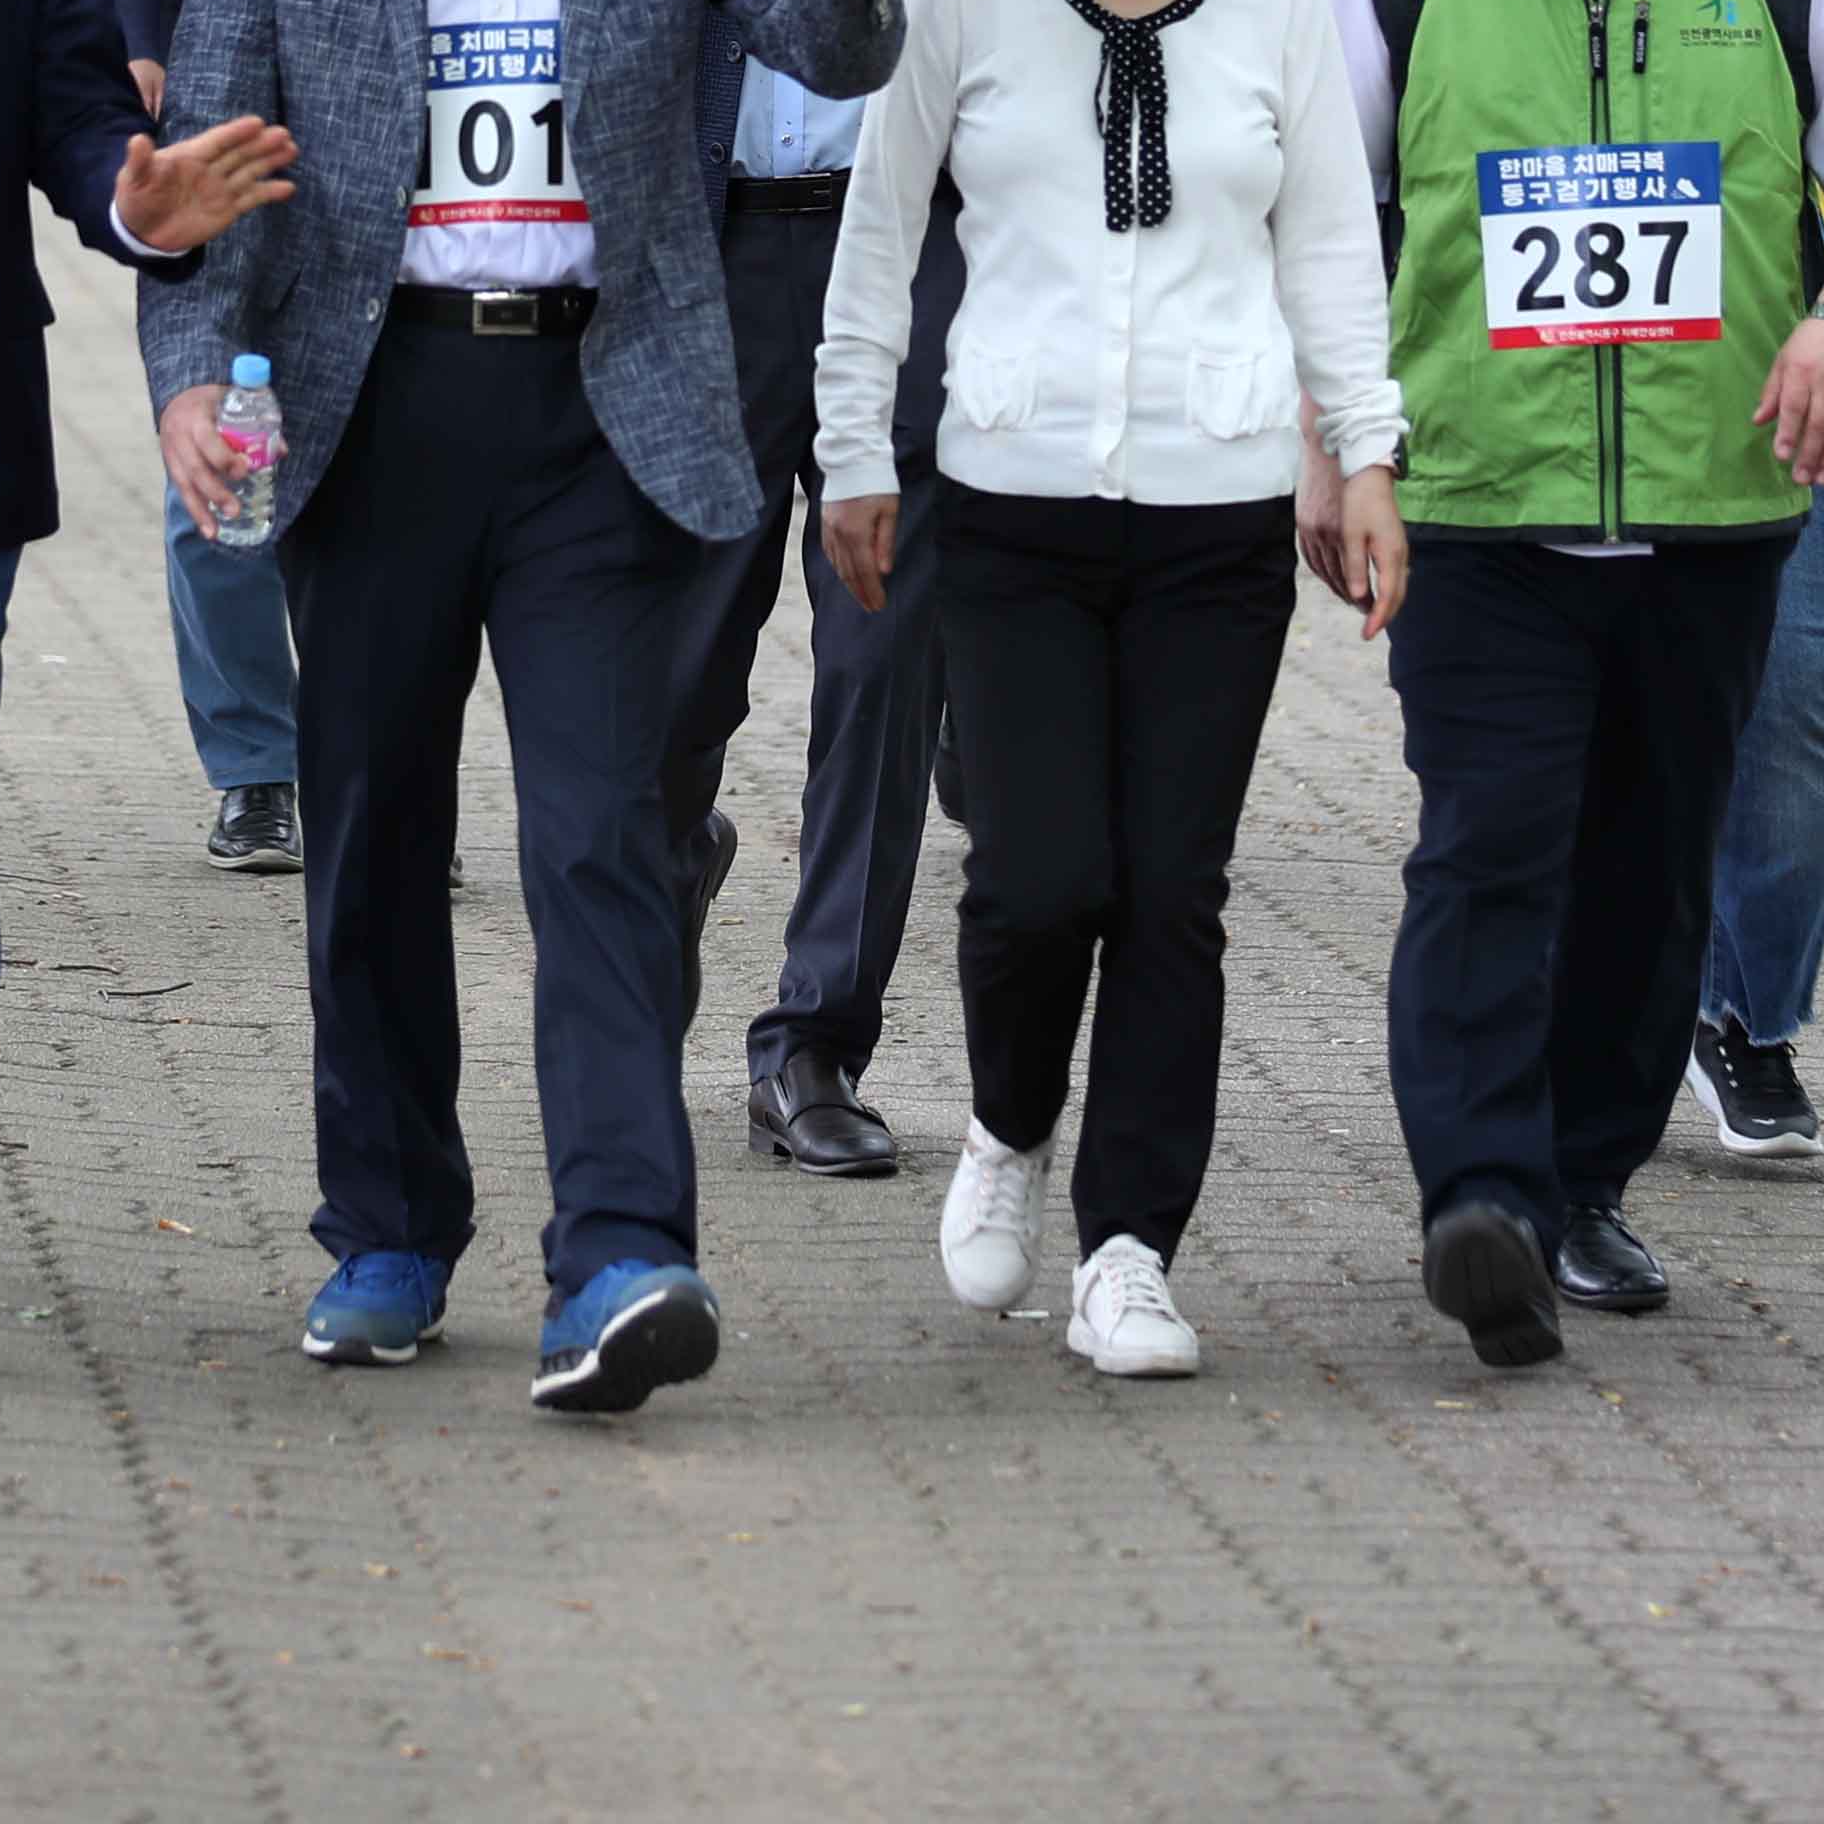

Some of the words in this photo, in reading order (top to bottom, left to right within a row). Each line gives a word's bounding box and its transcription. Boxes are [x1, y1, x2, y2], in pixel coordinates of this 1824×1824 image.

[460, 27, 557, 53] 치매극복
[427, 53, 558, 83] 걷기행사
[1498, 154, 1567, 181] 한마음
[1573, 151, 1666, 176] 치매극복
[1511, 220, 1690, 313] 287
